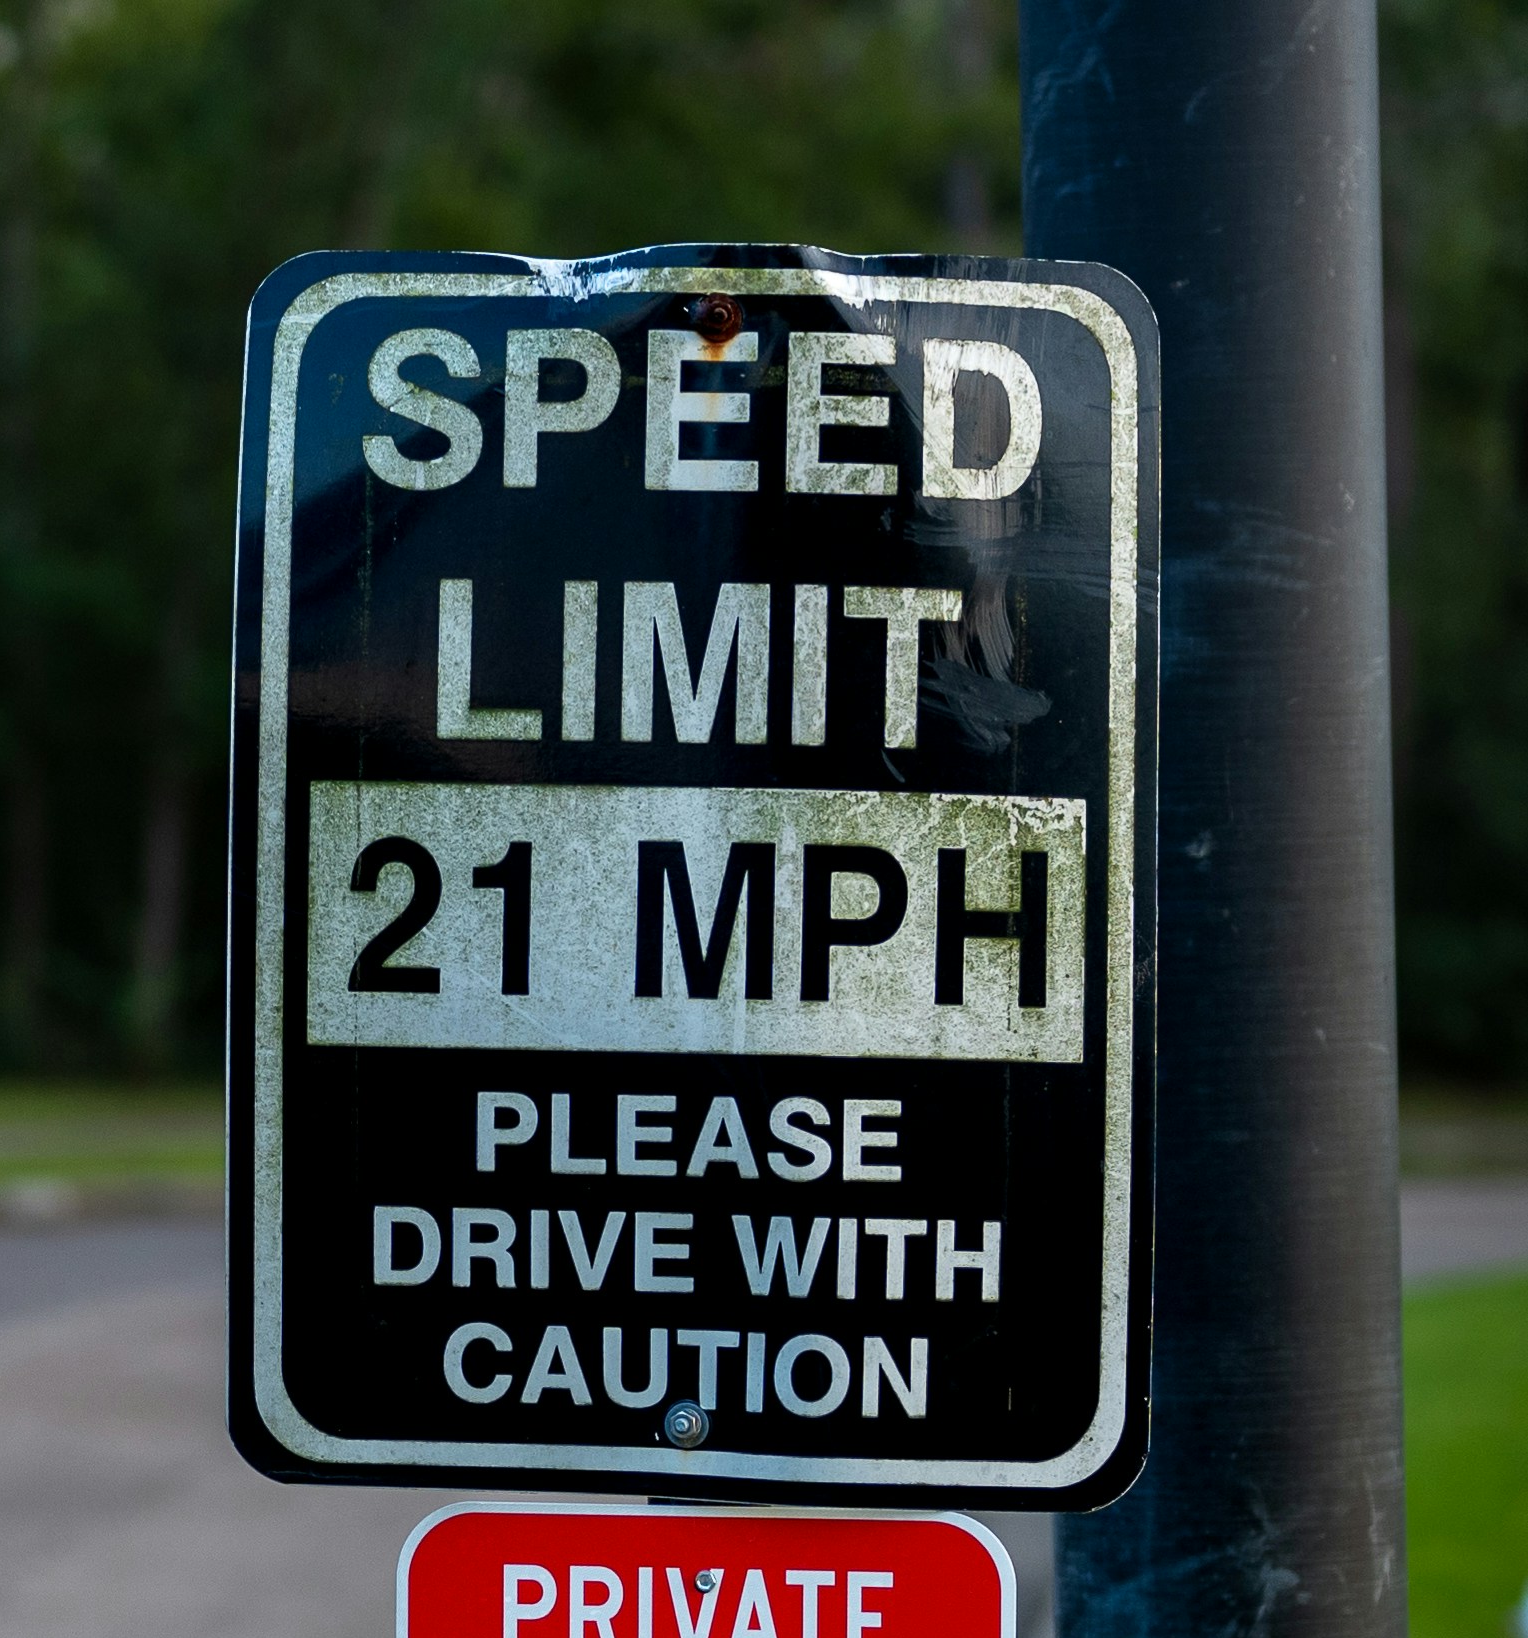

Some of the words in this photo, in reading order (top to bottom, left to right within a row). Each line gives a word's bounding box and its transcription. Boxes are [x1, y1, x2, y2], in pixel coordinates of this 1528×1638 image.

[363, 326, 1042, 501] SPEED
[437, 579, 962, 748] LIMIT
[348, 836, 532, 995] 21
[635, 841, 1048, 1007] MPH
[477, 1092, 901, 1181] PLEASE
[374, 1206, 694, 1292] DRIVE
[732, 1215, 1001, 1301] WITH
[444, 1323, 928, 1417] CAUTION
